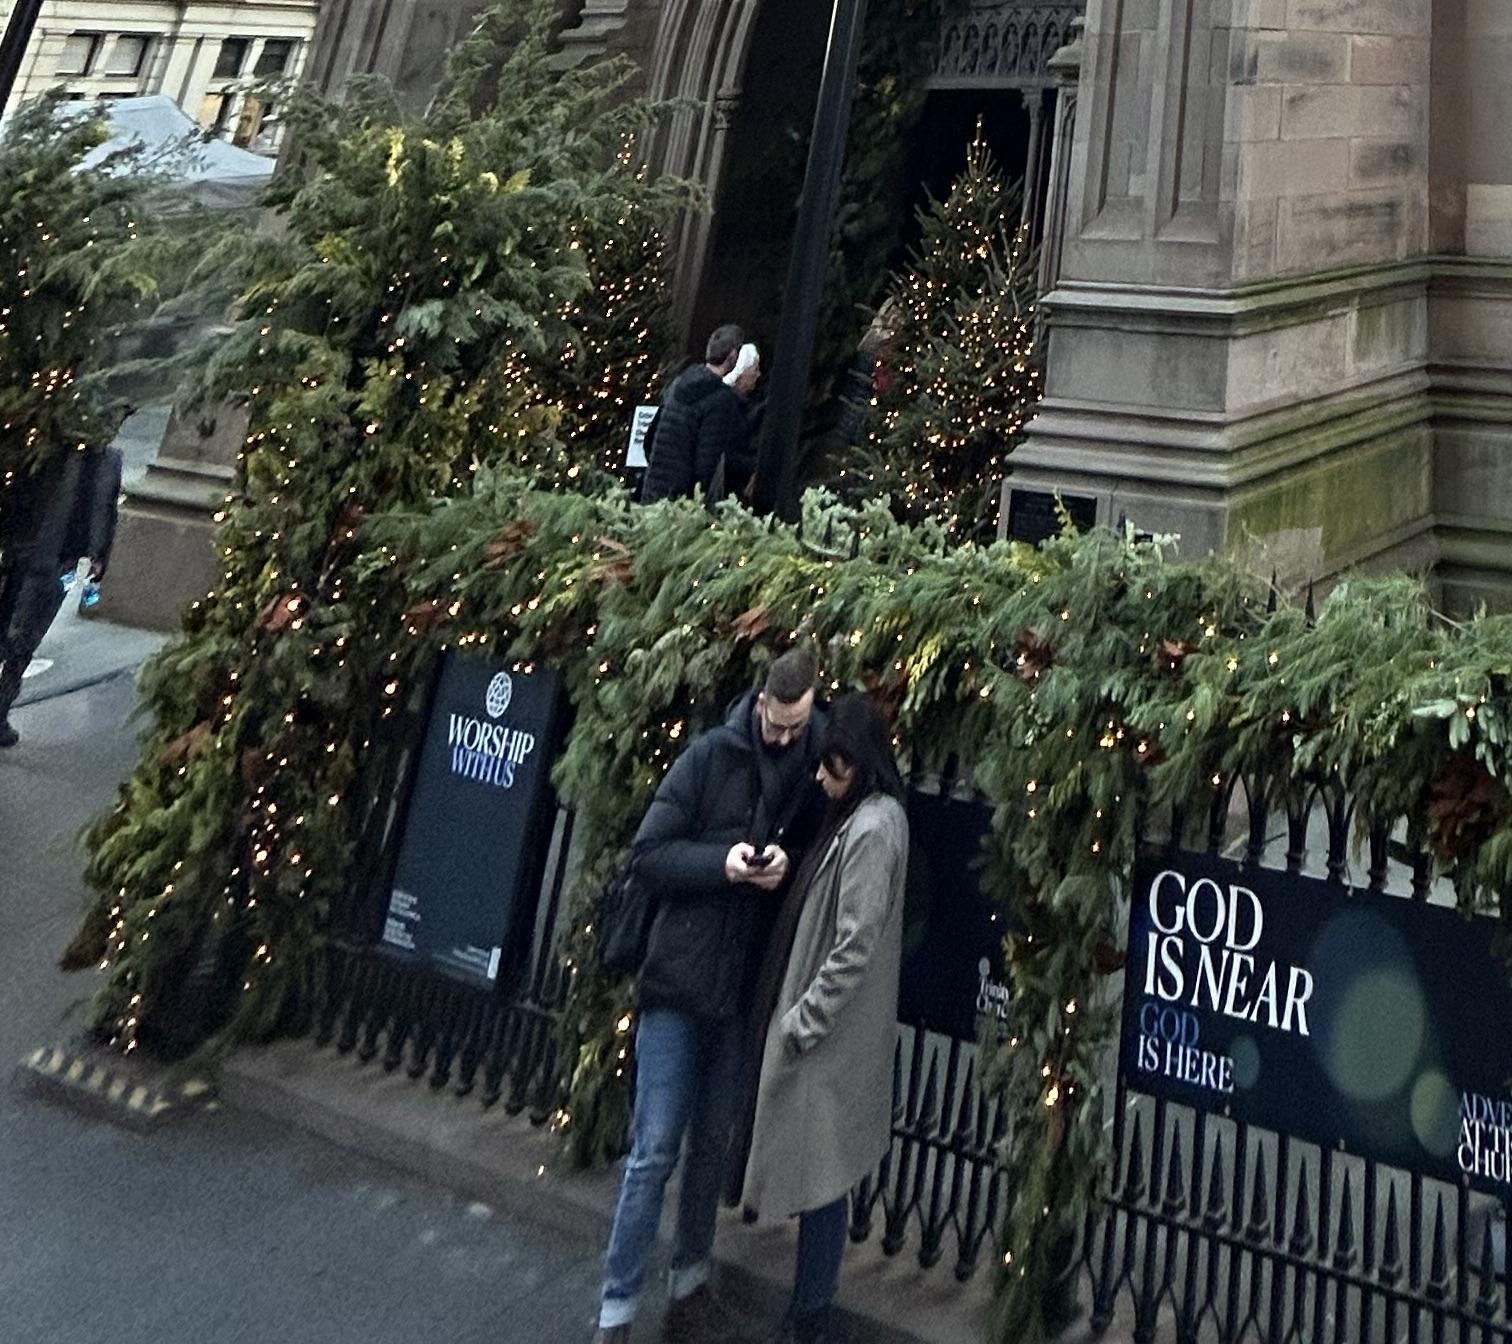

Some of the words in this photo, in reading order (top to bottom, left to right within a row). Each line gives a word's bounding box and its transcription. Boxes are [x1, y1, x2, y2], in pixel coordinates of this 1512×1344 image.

[448, 713, 535, 765] WORSHIP
[452, 745, 496, 783] WITH
[493, 755, 517, 789] US
[1149, 869, 1264, 951] GOD
[1144, 931, 1185, 1002] IS
[1190, 943, 1314, 1036] NEAR
[1140, 1002, 1200, 1047] GOD
[1137, 1034, 1159, 1072] IS
[1164, 1040, 1235, 1094] HERE
[1459, 1117, 1486, 1156] AT
